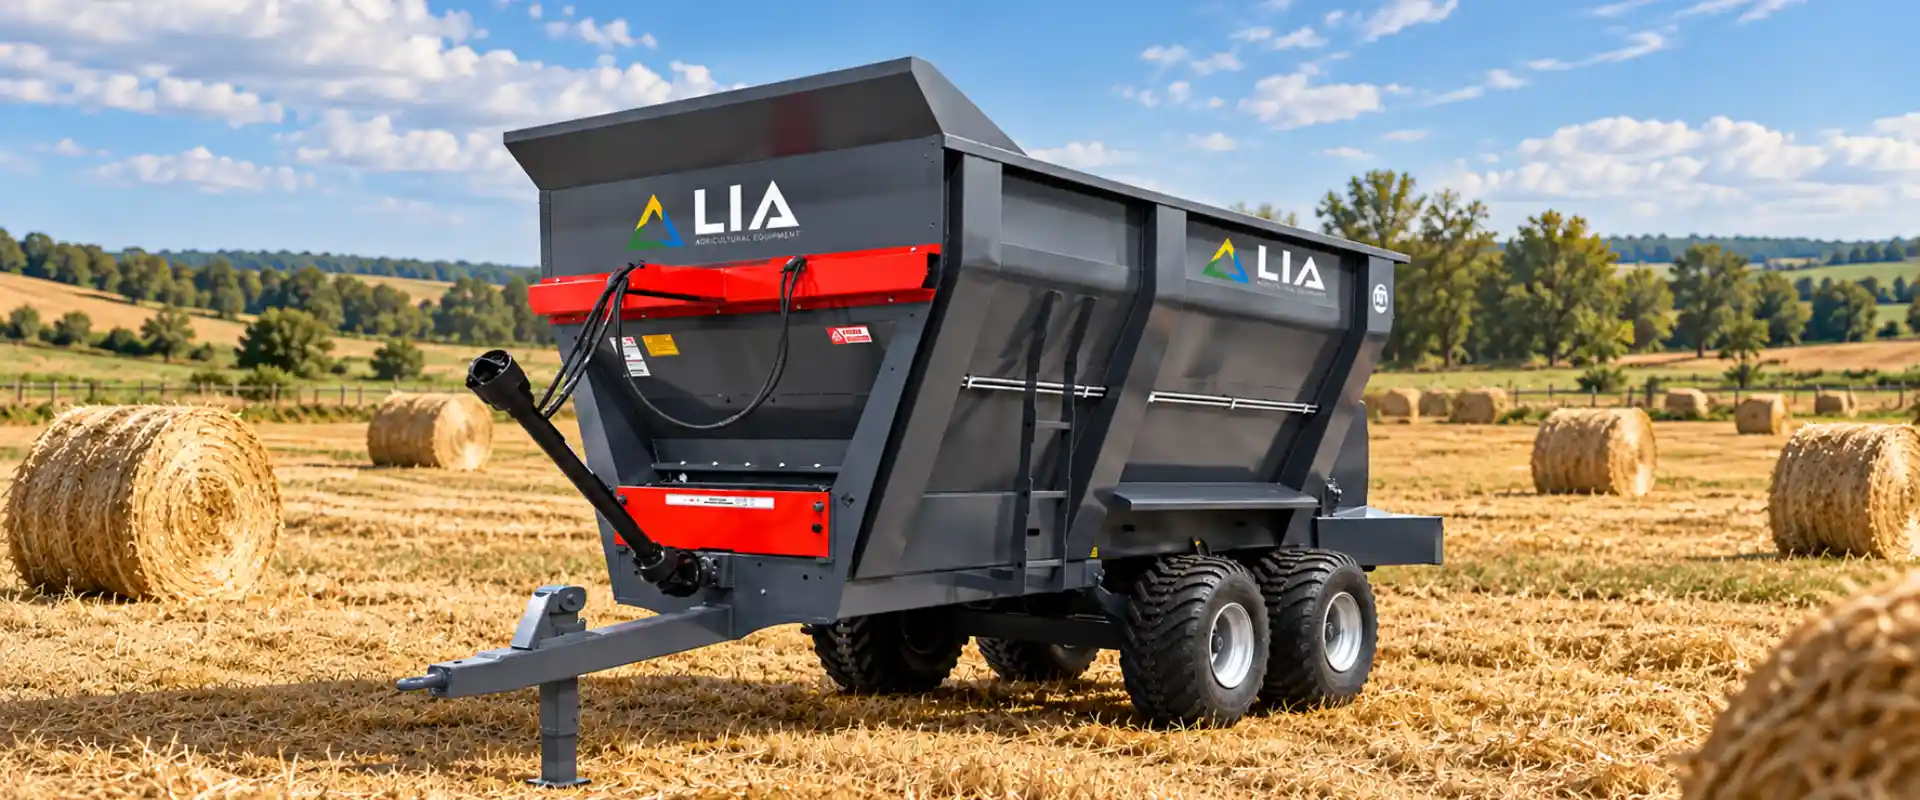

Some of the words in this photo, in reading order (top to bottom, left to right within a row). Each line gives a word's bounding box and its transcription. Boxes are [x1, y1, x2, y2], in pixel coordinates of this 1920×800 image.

[694, 180, 800, 235] LIA
[695, 234, 751, 246] AGRICULTURAL
[1258, 245, 1326, 291] LIA
